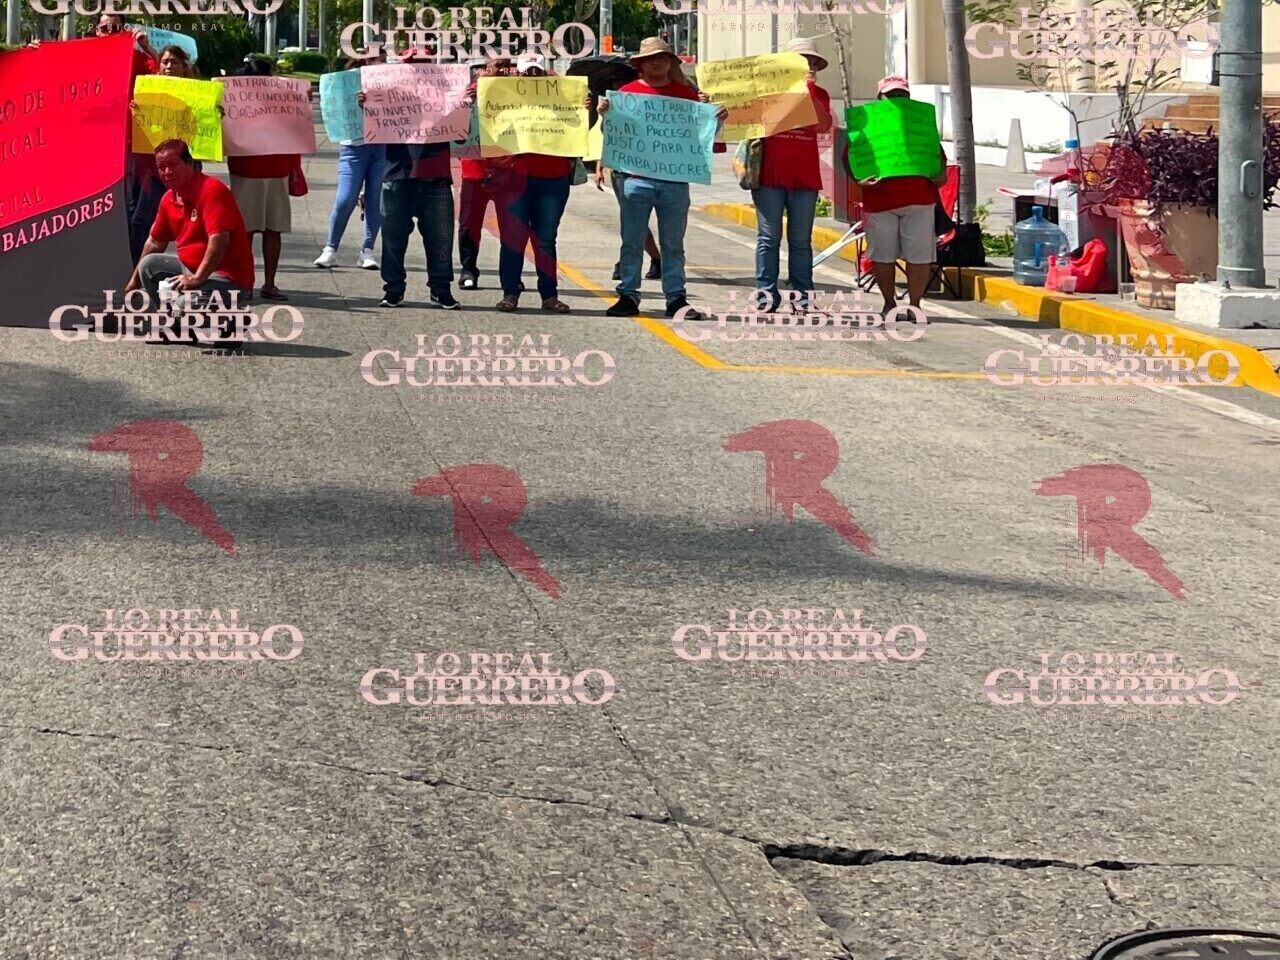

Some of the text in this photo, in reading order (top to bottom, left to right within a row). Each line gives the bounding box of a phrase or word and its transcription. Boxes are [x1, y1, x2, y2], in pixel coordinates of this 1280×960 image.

[516, 78, 560, 96] CTM
[23, 88, 47, 116] DE
[59, 76, 104, 106] 1936
[365, 101, 443, 117] NO INVENTOS
[644, 100, 658, 111] AL
[375, 117, 412, 129] FRAUDE
[644, 112, 704, 126] PROCESAL
[396, 126, 458, 140] PROCESAL
[646, 124, 691, 139] PROCESO
[605, 135, 712, 159] JUSTO PARA LOS
[611, 149, 711, 176] TRABAJADORES
